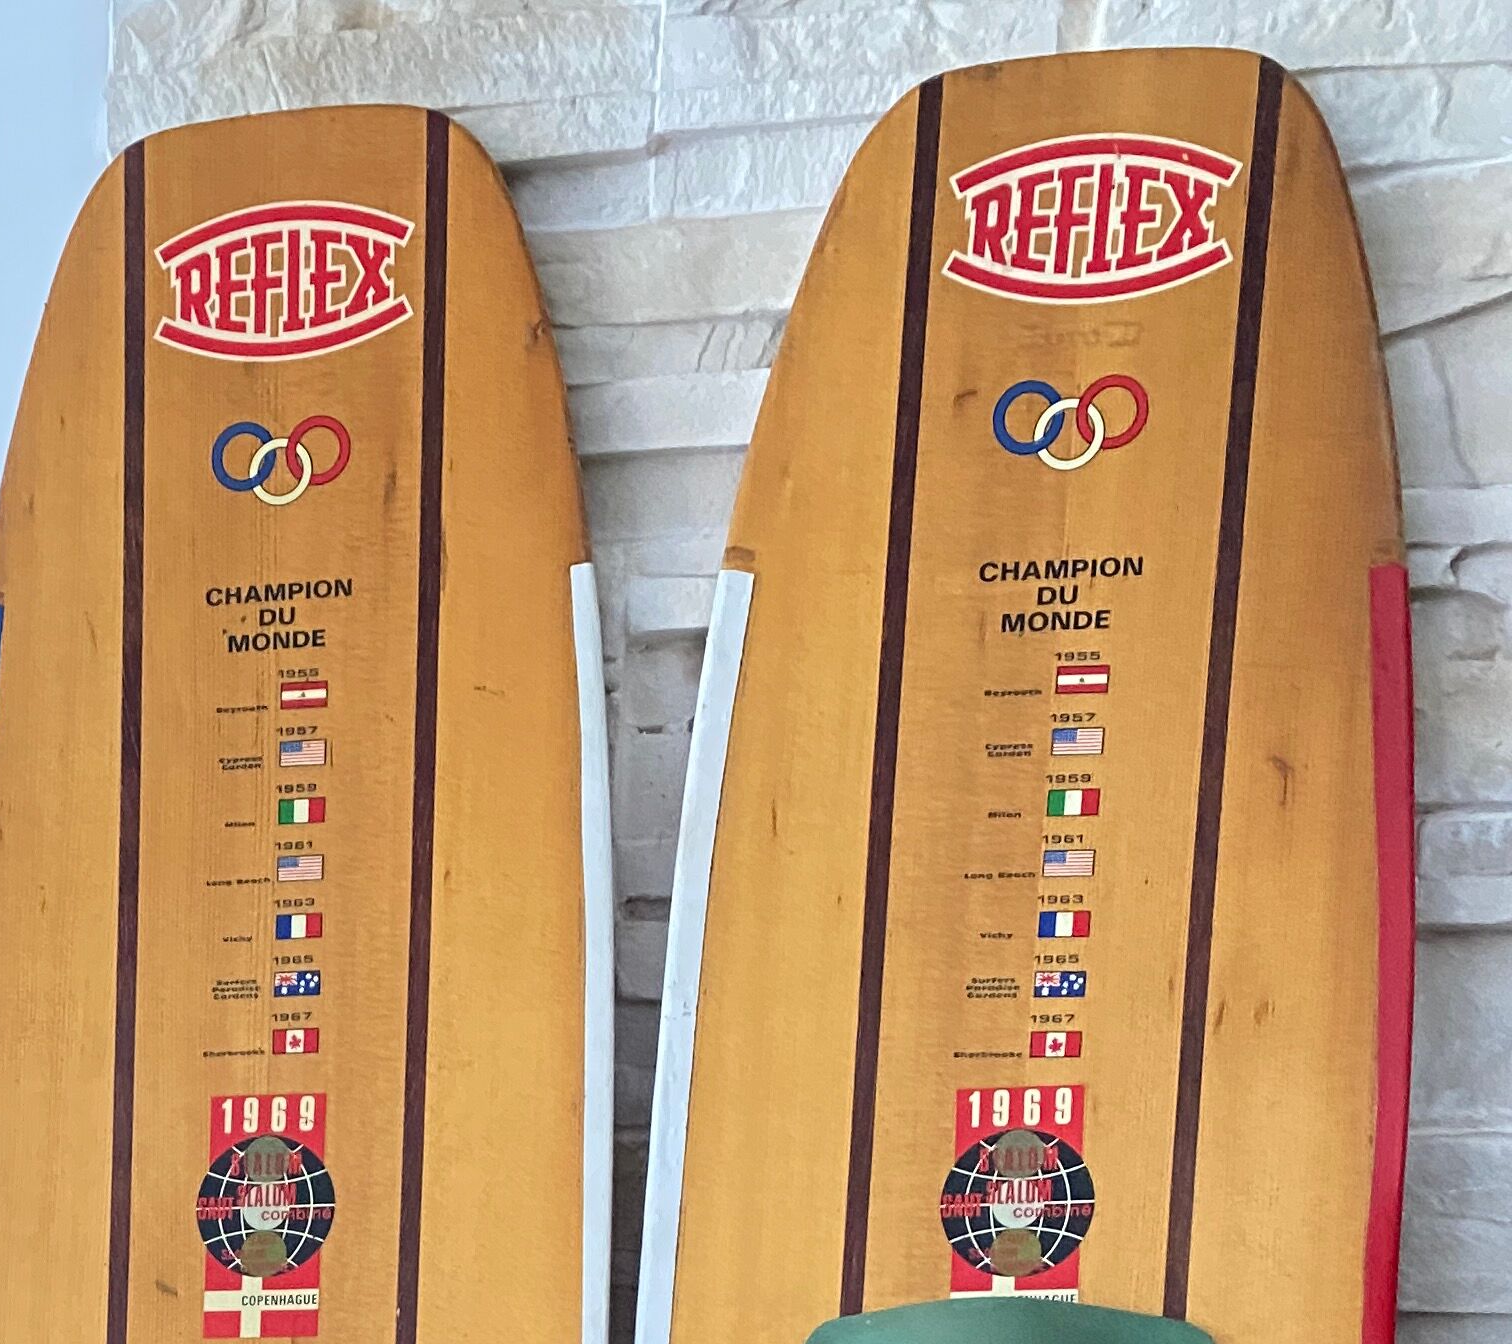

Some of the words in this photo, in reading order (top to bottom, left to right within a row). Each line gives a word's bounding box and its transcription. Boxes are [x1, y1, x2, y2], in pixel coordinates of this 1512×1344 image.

[970, 163, 1215, 275] REFLEX
[175, 228, 393, 335] REFLEX
[978, 556, 1144, 583] CHAMPION
[205, 578, 353, 606] CHAMPION
[1036, 585, 1079, 606] DU
[258, 607, 296, 627] DU
[1000, 609, 1112, 633] MONDE
[227, 629, 326, 653] MONDE
[1054, 652, 1101, 661] 1955
[279, 668, 319, 678] 1955
[1051, 713, 1096, 723] 1957
[277, 783, 317, 793] 1959
[1045, 774, 1091, 784] 1959
[1043, 834, 1084, 844] 1961
[1038, 894, 1084, 904] 1963
[1035, 954, 1079, 965] 1965
[272, 1012, 312, 1022] 1967
[1030, 1014, 1075, 1023] 1967
[221, 1095, 316, 1134] 1969
[968, 1087, 1074, 1128] 1969
[237, 1184, 297, 1207] SLALOM
[986, 1179, 1053, 1204] SLALOM
[241, 1293, 317, 1306] COPENHAGUE
